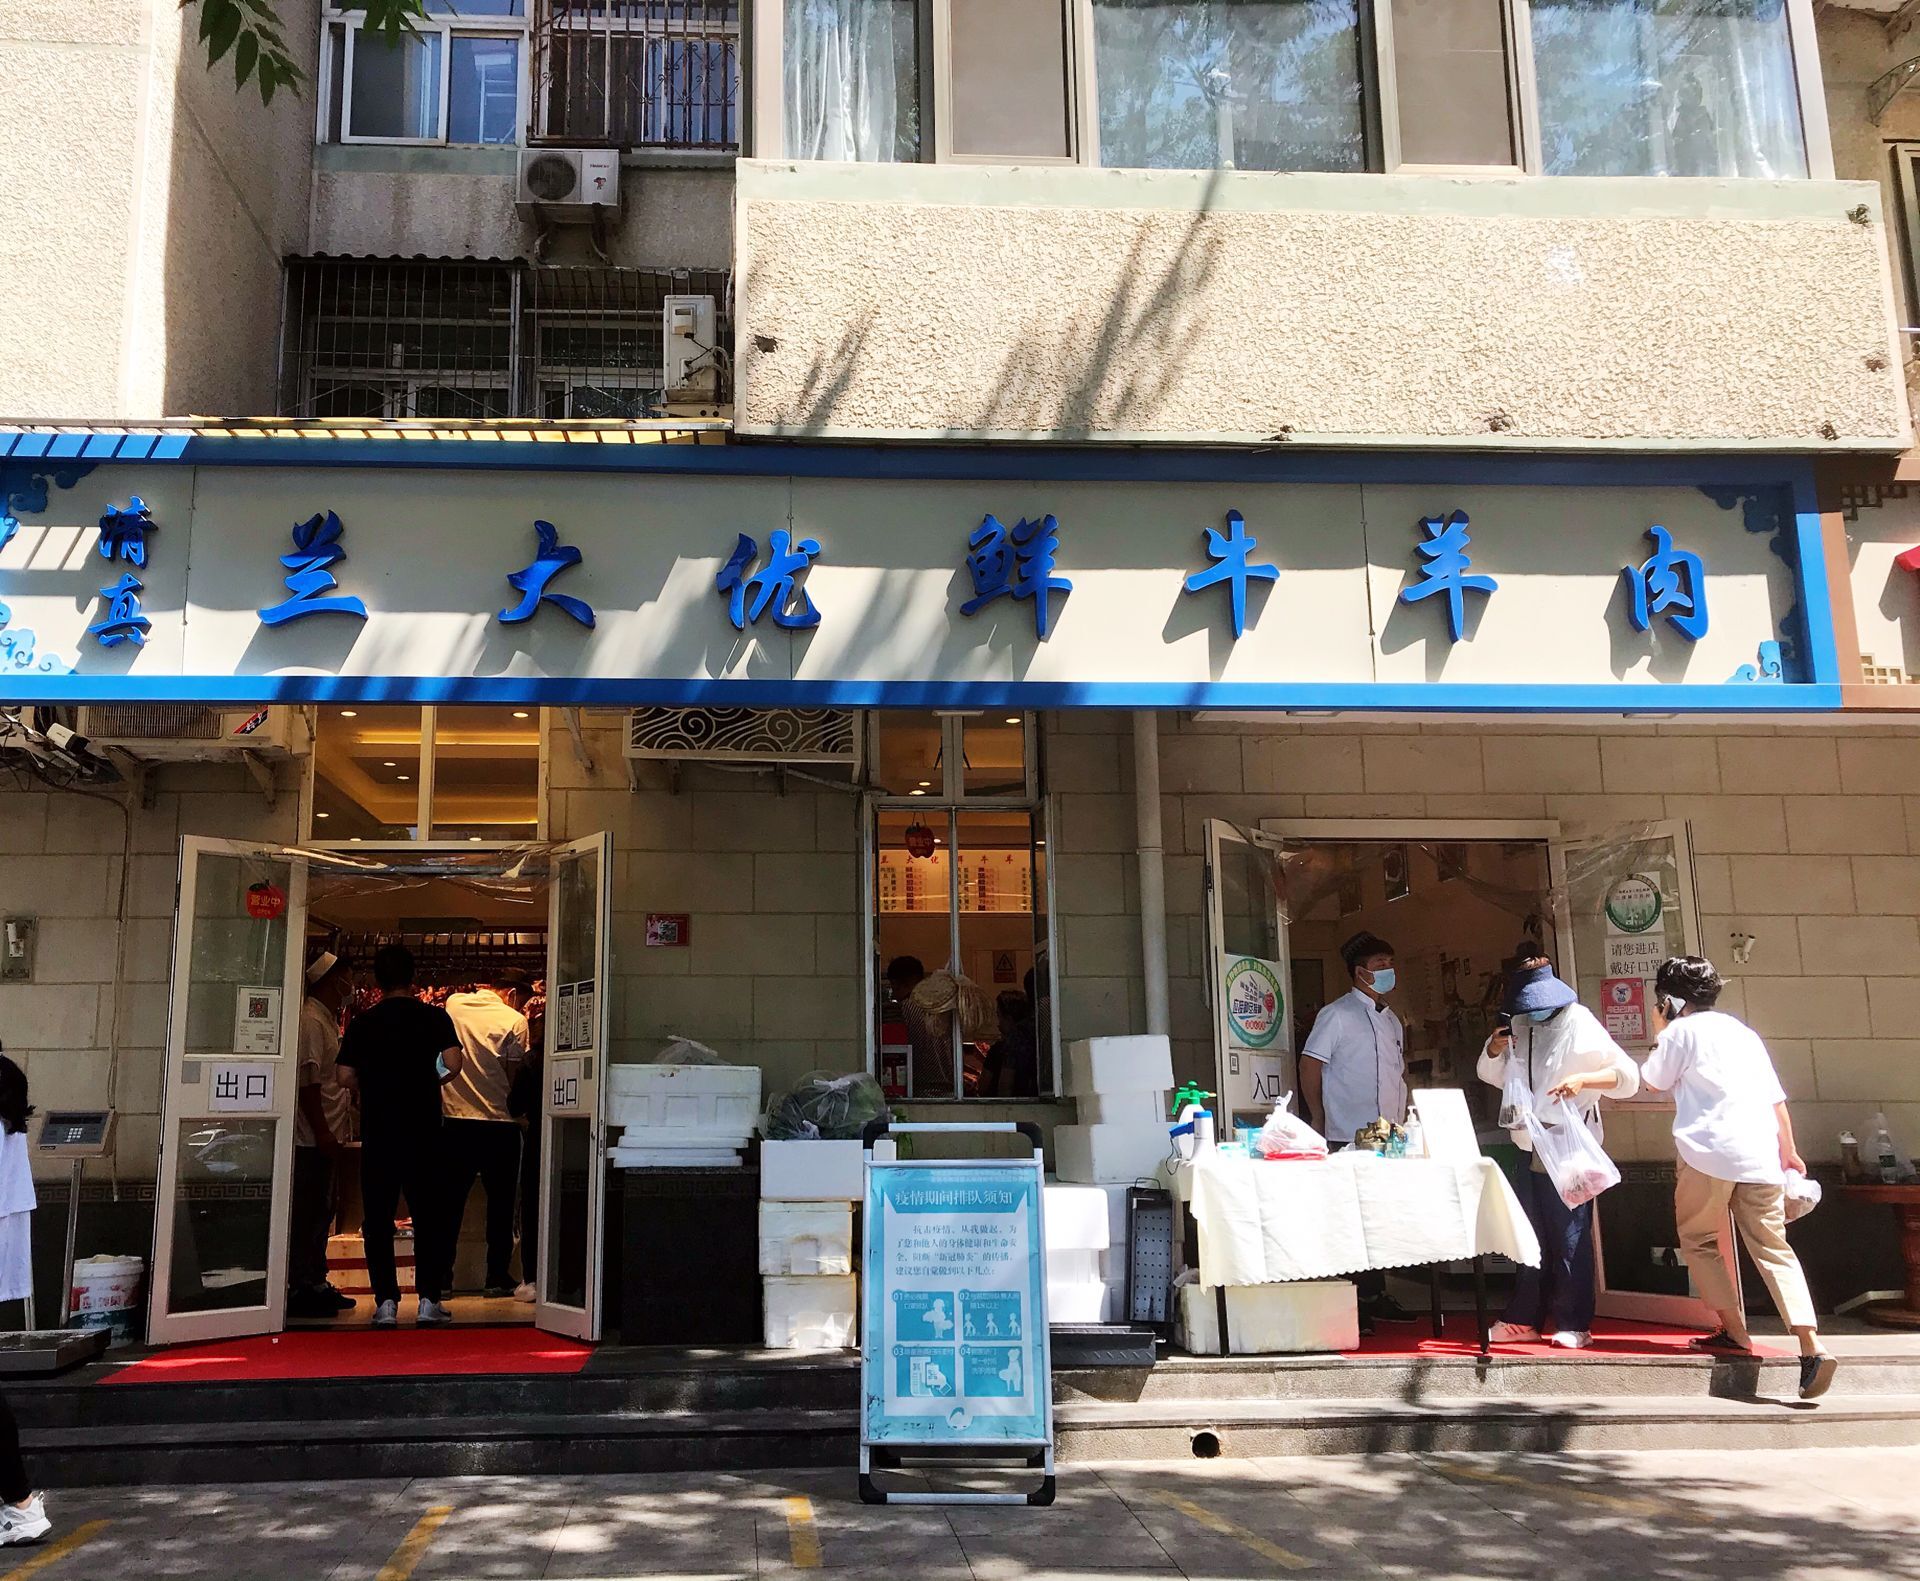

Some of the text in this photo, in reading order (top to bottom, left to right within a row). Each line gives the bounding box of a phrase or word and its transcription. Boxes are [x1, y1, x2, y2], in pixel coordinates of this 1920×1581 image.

[88, 494, 158, 647] 清真
[256, 508, 1710, 644] 兰大优鲜牛羊肉
[250, 894, 281, 908] 营业中
[1610, 942, 1660, 957] 请您进店
[216, 1071, 267, 1100] 出口
[553, 1077, 577, 1106] 出口
[1253, 1072, 1281, 1101] 入口
[895, 1189, 1012, 1206] 疫情期间排队须知
